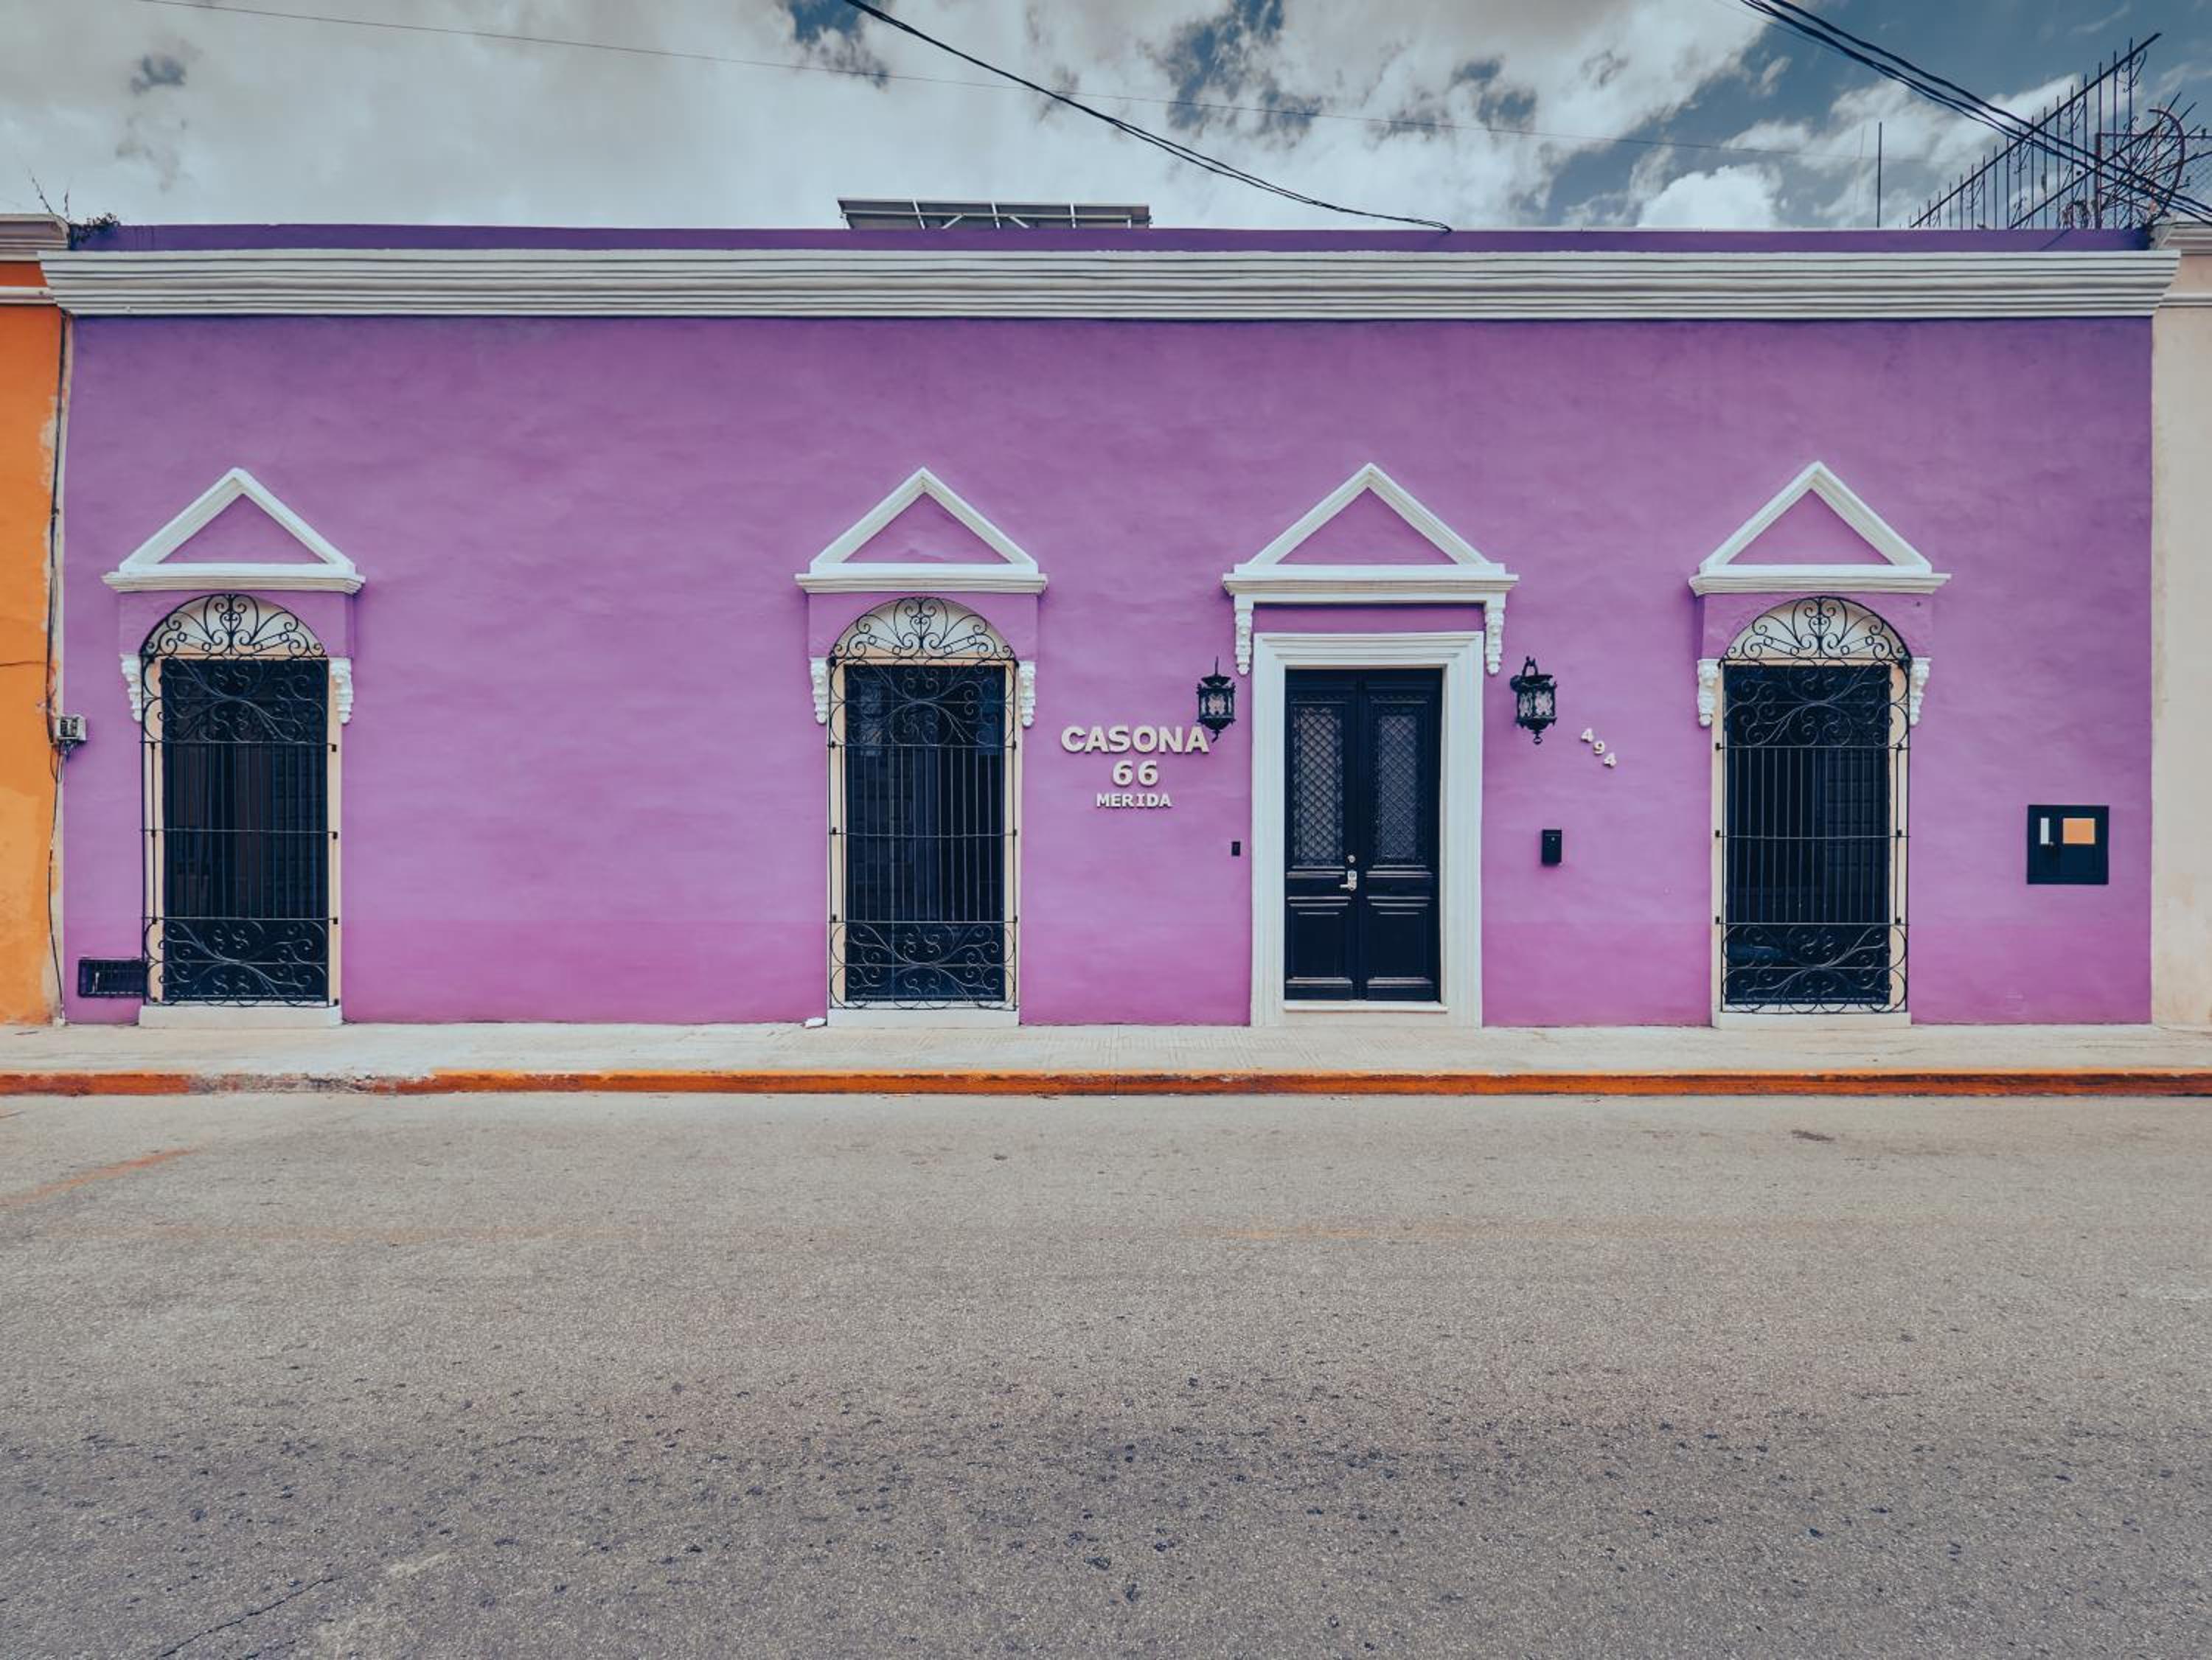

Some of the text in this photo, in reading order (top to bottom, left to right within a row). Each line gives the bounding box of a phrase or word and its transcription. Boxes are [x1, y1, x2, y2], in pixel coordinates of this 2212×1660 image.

[1061, 725, 1209, 753] CASONA
[1581, 728, 1617, 767] 494
[1112, 760, 1158, 786] 66
[1096, 793, 1172, 807] MERIDA
